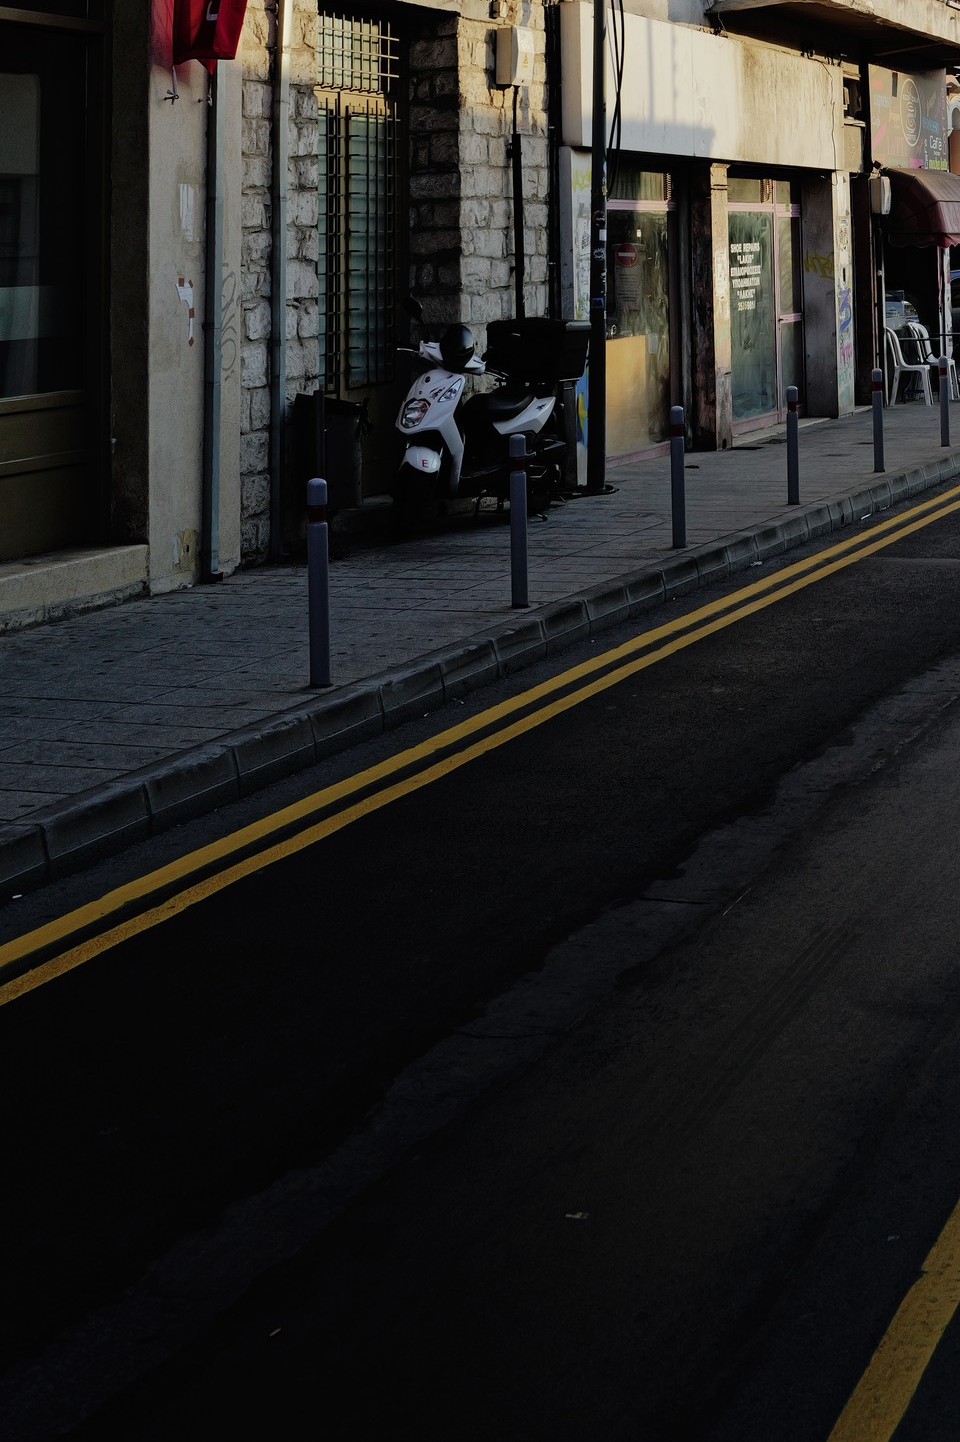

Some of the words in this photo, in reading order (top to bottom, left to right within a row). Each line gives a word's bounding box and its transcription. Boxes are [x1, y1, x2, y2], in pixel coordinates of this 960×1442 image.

[929, 135, 943, 151] Café
[730, 243, 743, 254] SHOE
[743, 242, 760, 253] REPAIRS
[421, 459, 429, 468] E
